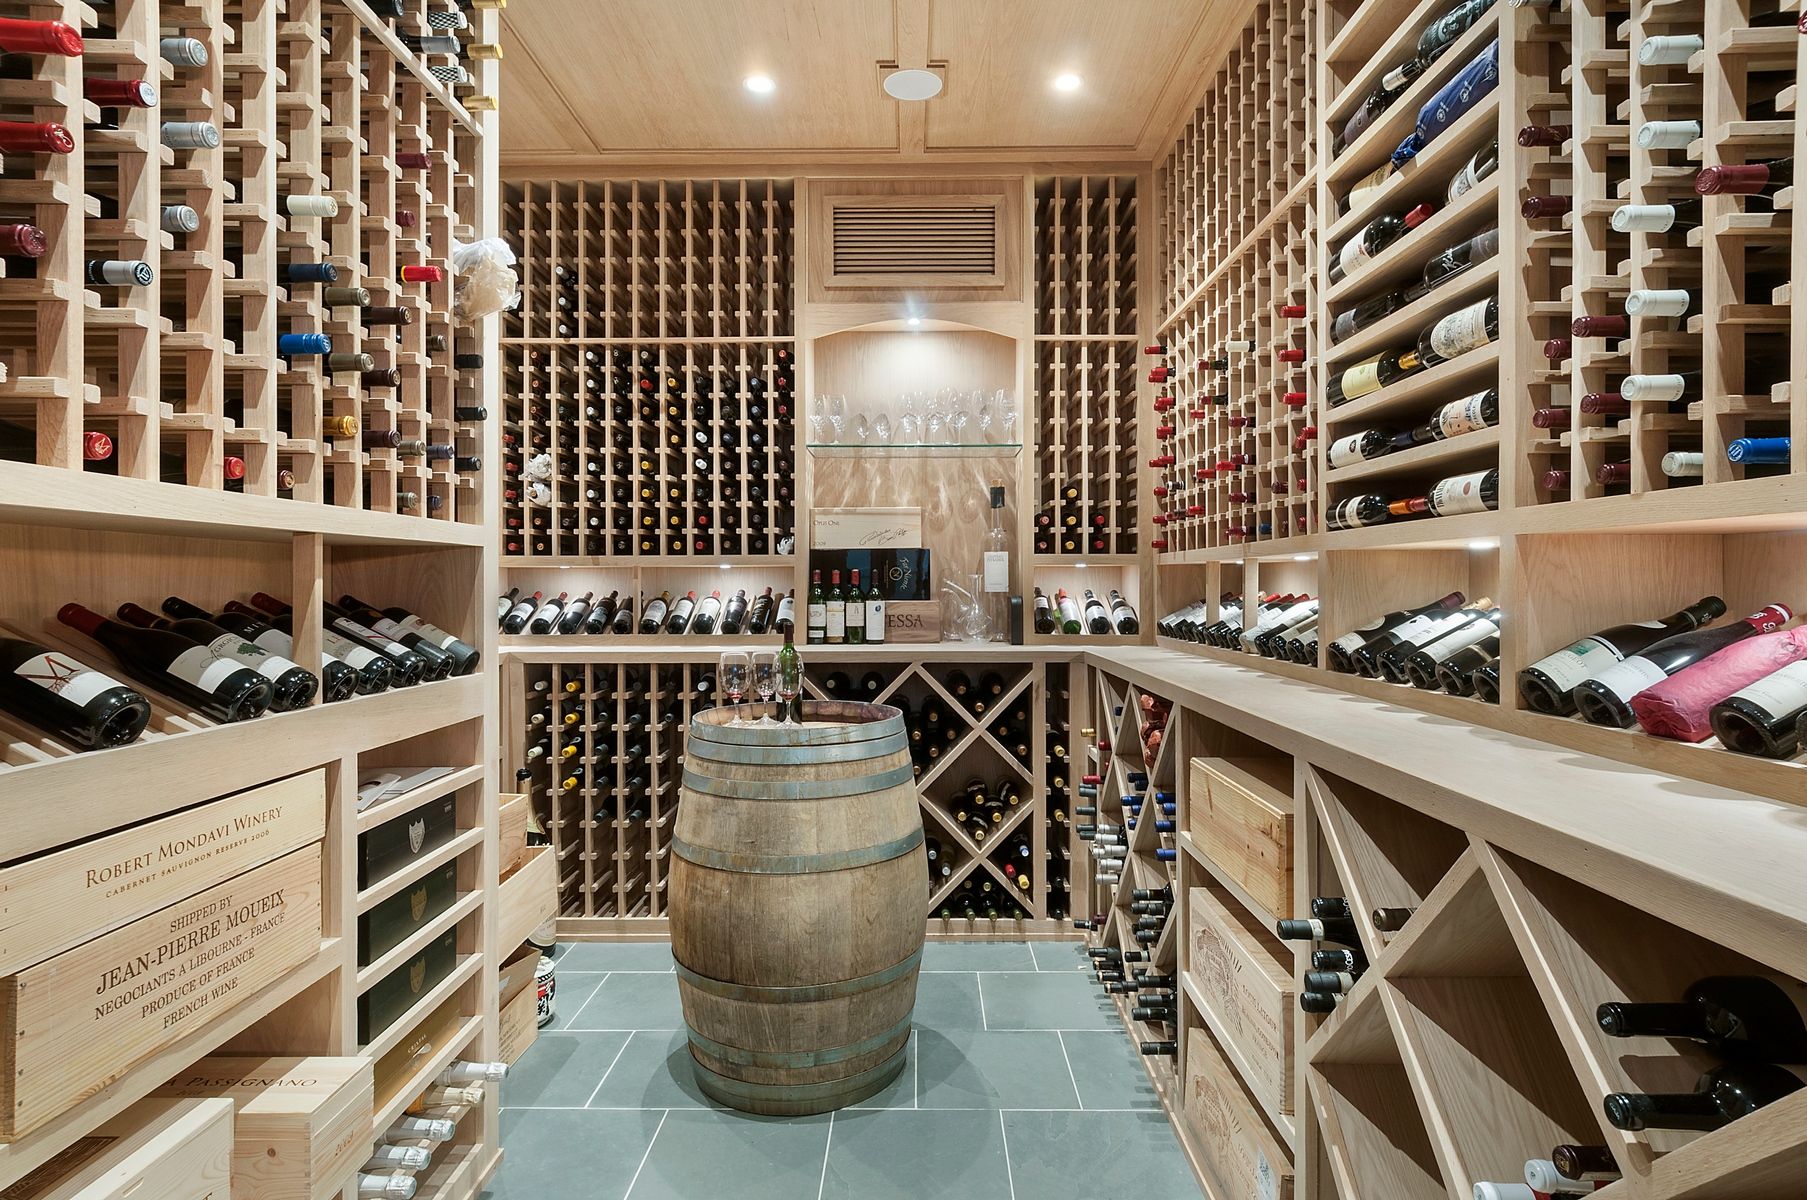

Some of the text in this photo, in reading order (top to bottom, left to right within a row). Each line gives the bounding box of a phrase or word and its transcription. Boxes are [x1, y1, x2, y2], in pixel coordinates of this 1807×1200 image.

[884, 614, 923, 628] ESSA
[86, 806, 283, 888] ROBERT MONDAVI WINERY
[105, 829, 270, 898] CABERNET SAUVIGNON RESERVE 2006
[96, 889, 285, 995] JEAN-PIERRE MOUEIX
[170, 895, 233, 933] SHIPPED BY
[94, 970, 176, 1021] NEGOCIANTS
[178, 965, 186, 977] A
[189, 935, 243, 971] LIBOURNE
[250, 912, 286, 939] FRANCE
[141, 947, 255, 1019] PRODUCE OF FRANCE
[162, 976, 239, 1030] FRENCH WINE
[186, 1077, 318, 1087] PASSIGNANO
